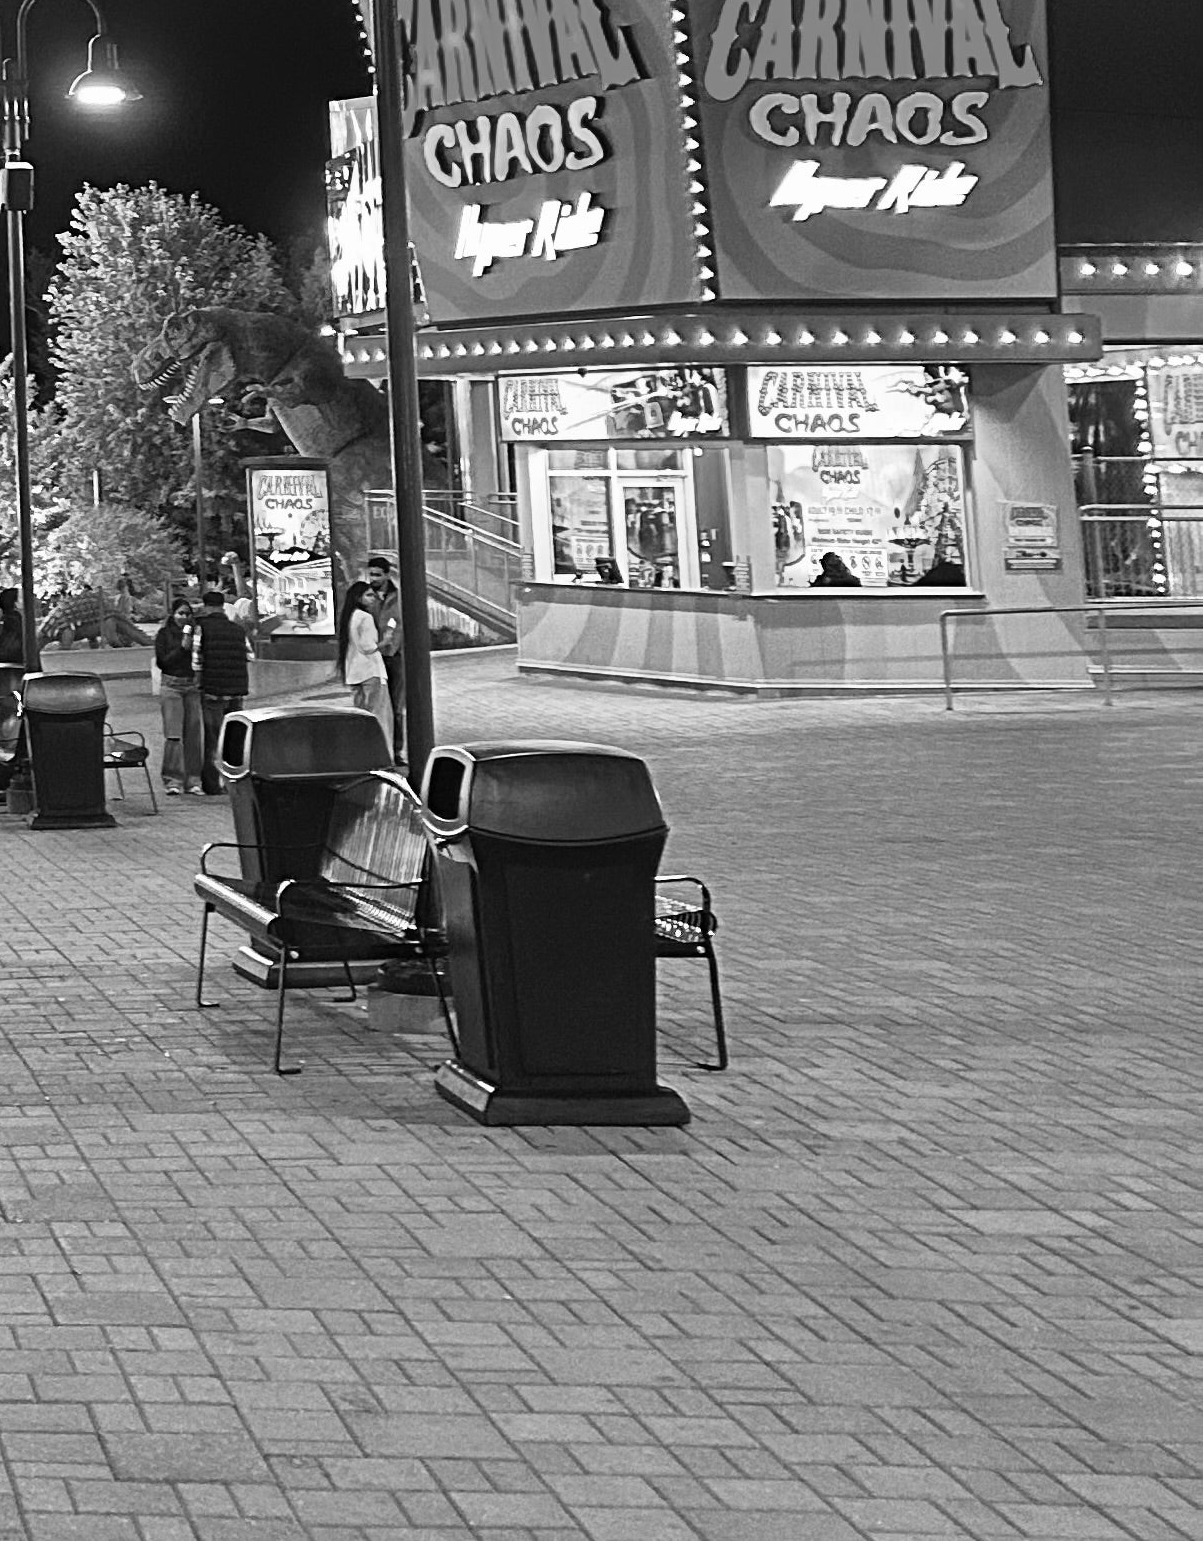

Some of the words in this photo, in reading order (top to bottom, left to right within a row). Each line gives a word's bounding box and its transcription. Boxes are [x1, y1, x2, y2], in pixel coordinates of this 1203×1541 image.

[749, 92, 989, 147] CHAOS
[424, 96, 604, 188] CHAOS
[758, 371, 880, 416] CARNIVAL
[512, 416, 559, 435] CHAOS
[775, 413, 861, 433] CHAOS
[820, 470, 861, 484] CHAOS
[265, 498, 313, 509] CHAOS
